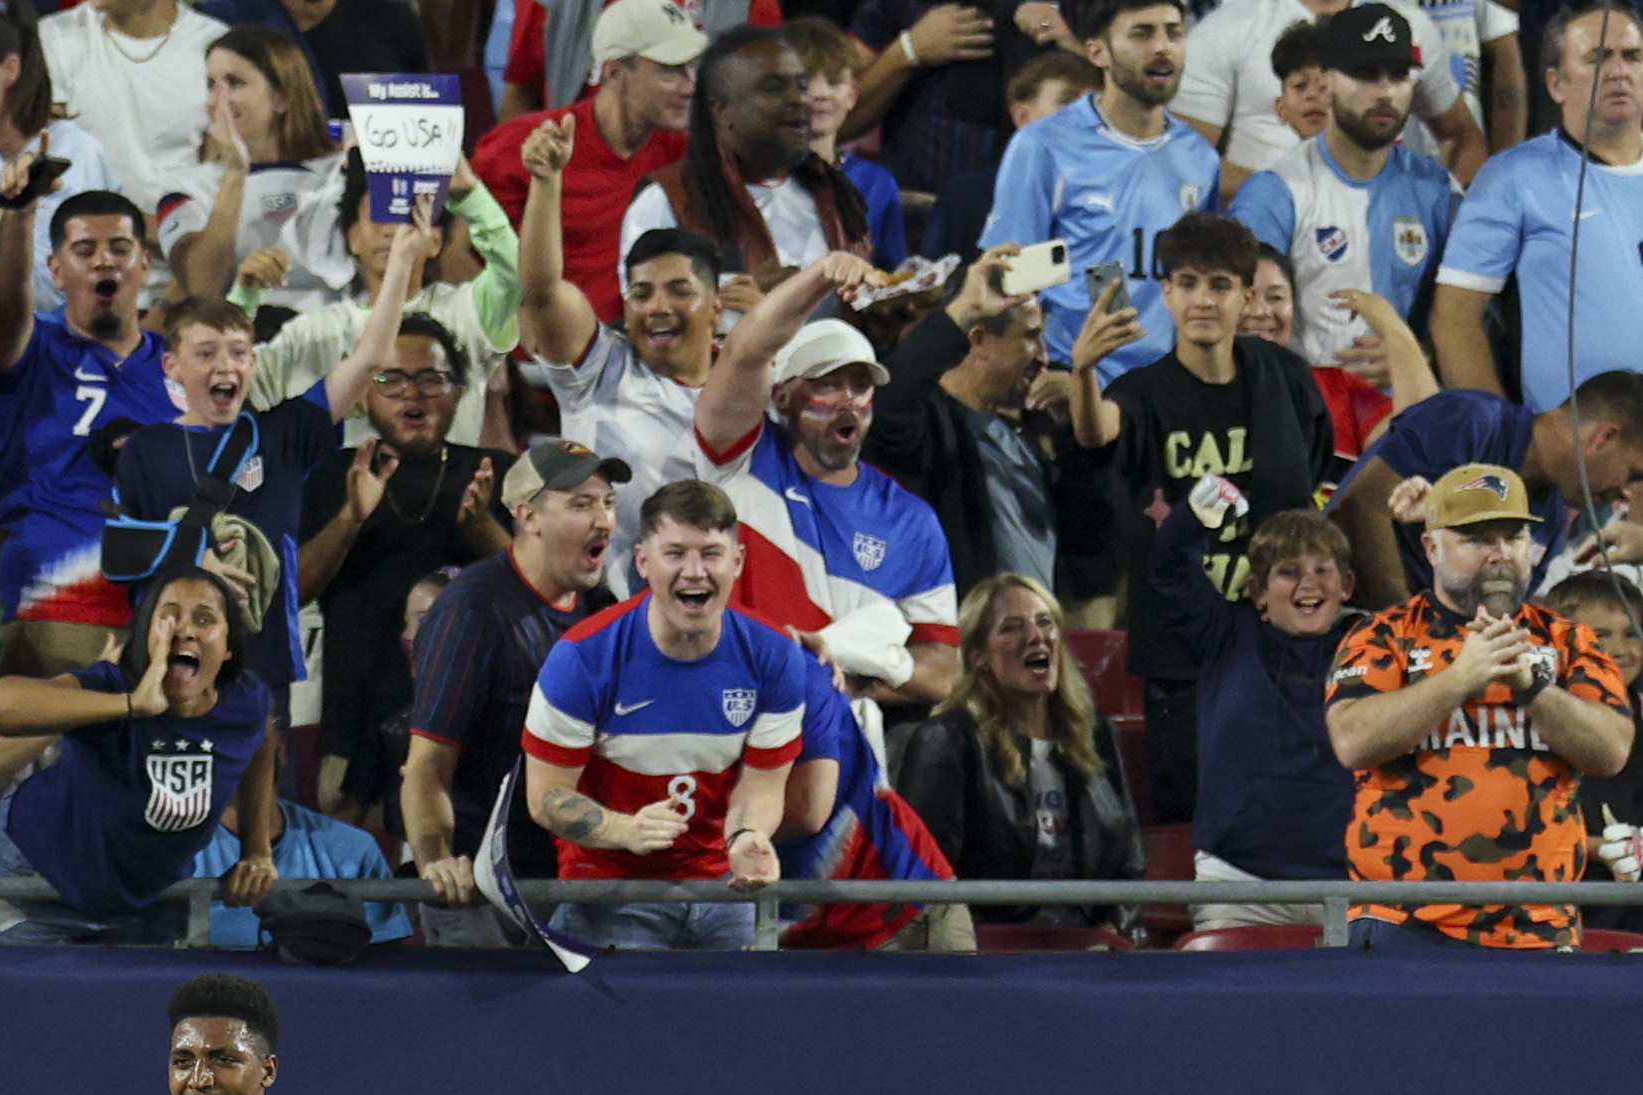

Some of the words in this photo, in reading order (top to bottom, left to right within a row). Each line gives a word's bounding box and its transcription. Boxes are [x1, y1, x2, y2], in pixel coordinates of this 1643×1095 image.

[72, 385, 107, 437] 7
[1165, 426, 1253, 479] CAL
[151, 760, 208, 795] USA
[667, 774, 697, 821] 8
